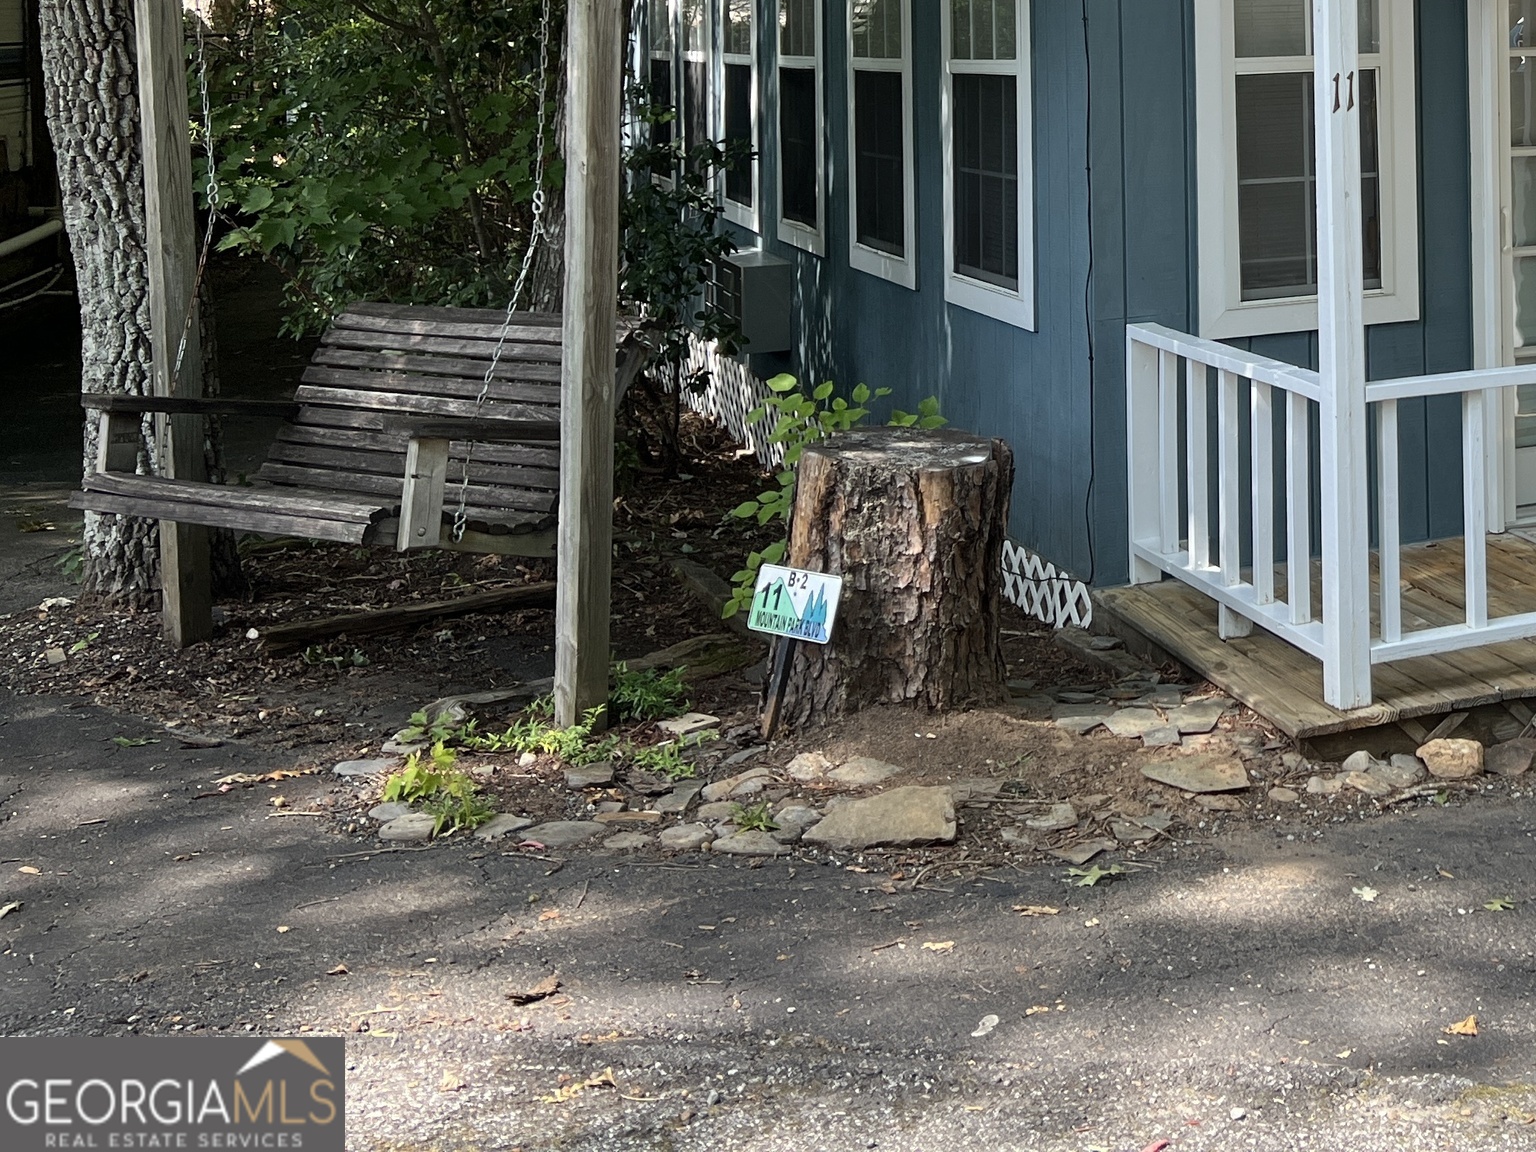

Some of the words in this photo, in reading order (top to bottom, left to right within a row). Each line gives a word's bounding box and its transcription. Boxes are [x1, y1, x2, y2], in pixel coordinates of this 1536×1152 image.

[1332, 70, 1354, 114] 11
[761, 582, 783, 610] 11
[755, 610, 788, 631] MOUNTAIN
[787, 617, 804, 634] PARK
[803, 620, 821, 637] BLVD
